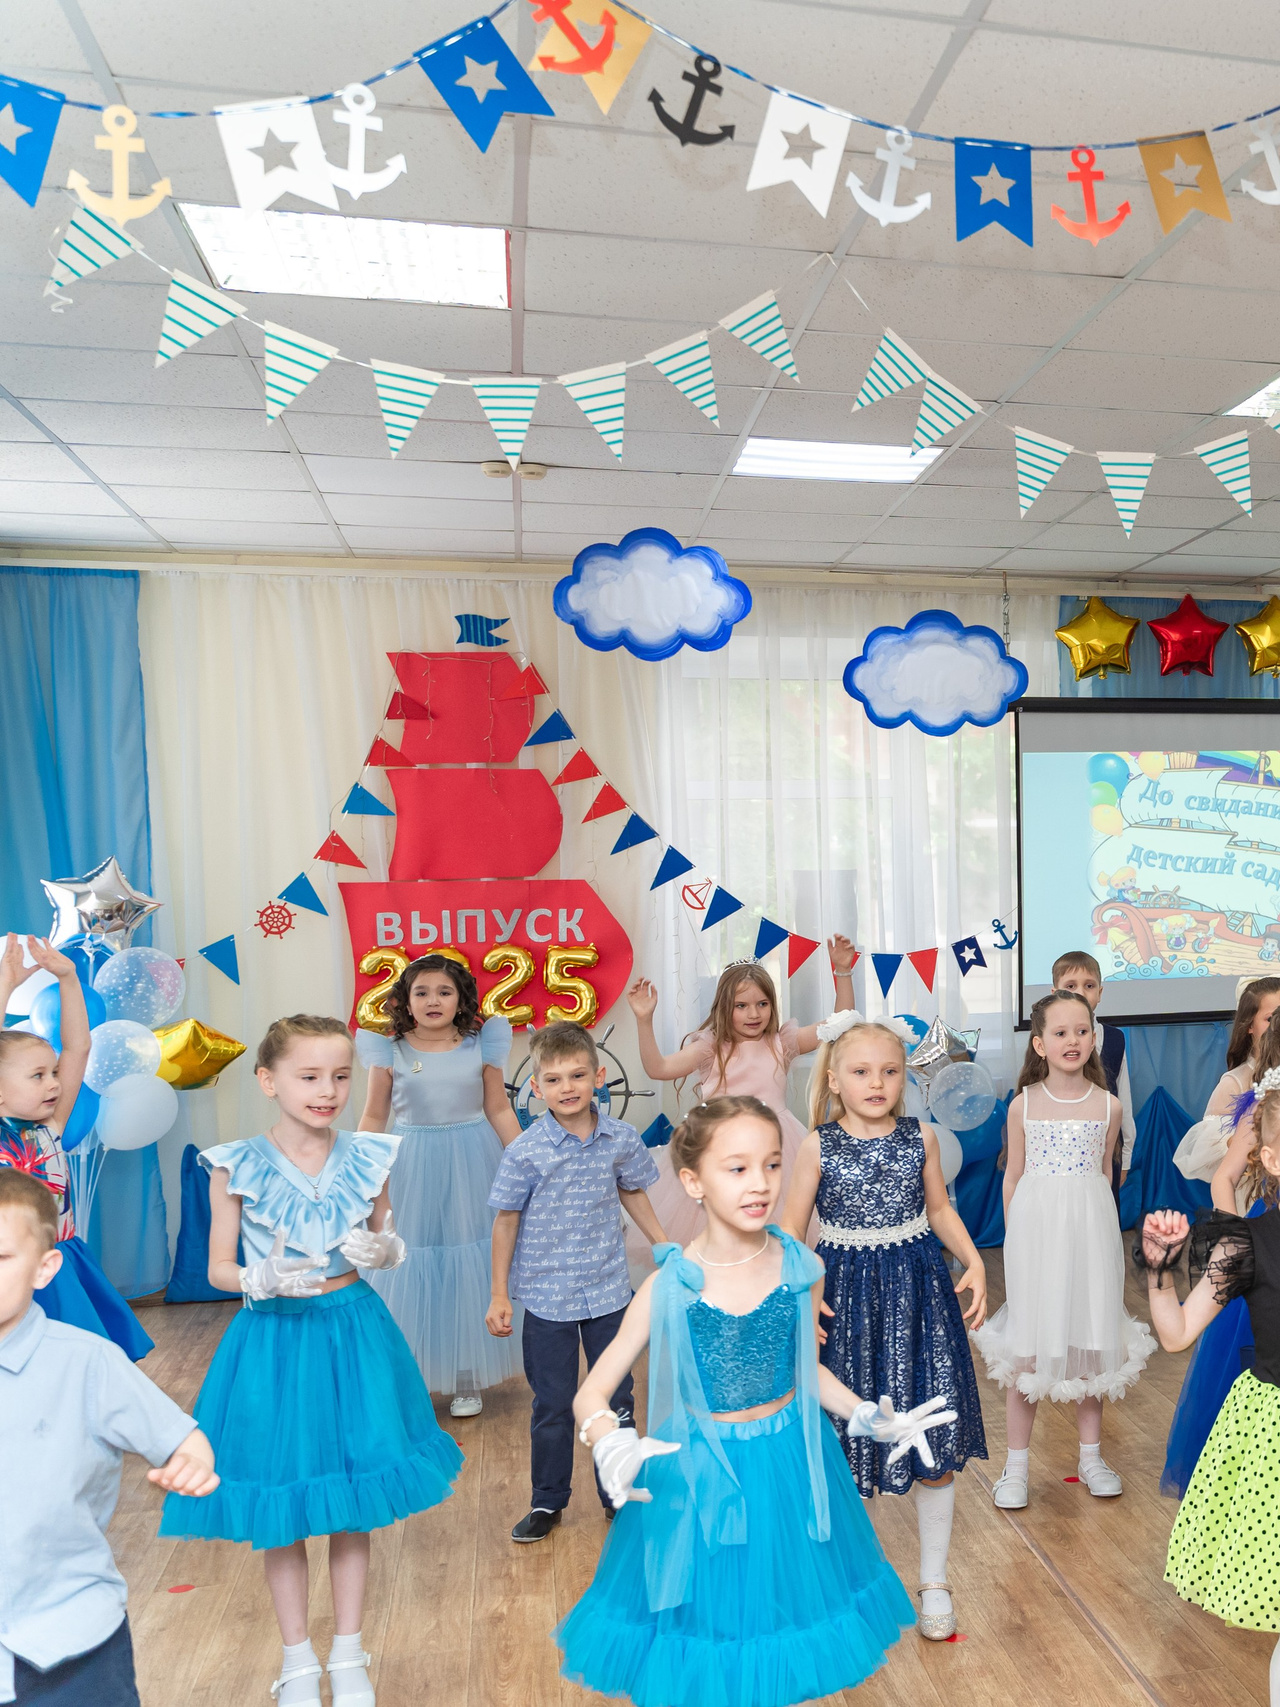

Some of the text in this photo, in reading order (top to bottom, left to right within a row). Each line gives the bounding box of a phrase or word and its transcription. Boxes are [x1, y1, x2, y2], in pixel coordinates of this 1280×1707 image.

[1138, 778, 1174, 808] До
[1126, 844, 1236, 875] детский
[376, 908, 586, 947] ВЫПУСК
[356, 943, 600, 1035] 225
[520, 1103, 529, 1126] COME
